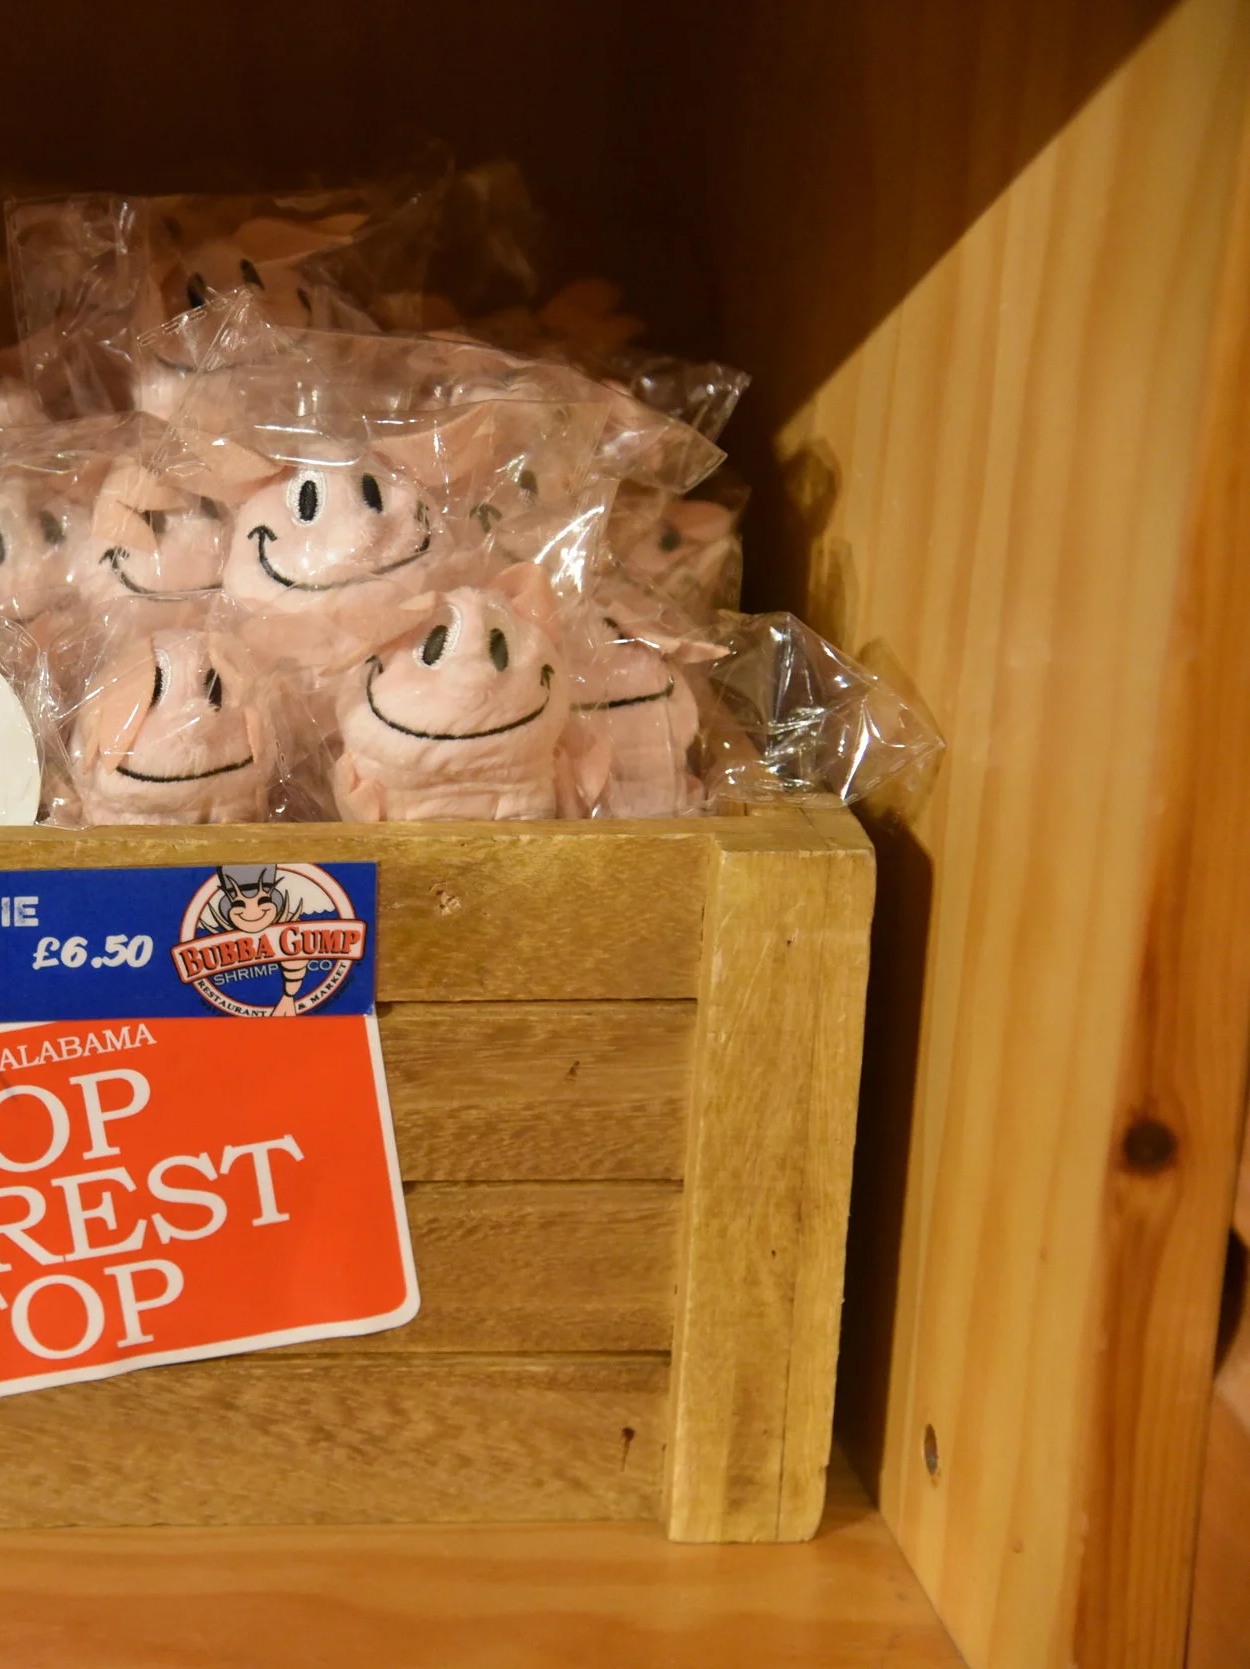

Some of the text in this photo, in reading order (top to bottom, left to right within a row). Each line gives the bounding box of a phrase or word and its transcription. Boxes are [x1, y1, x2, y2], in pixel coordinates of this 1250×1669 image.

[31, 934, 154, 971] £6.50
[179, 926, 362, 978] BUBBA GUMP
[213, 960, 333, 986] SHRIMP CO
[197, 980, 268, 1017] RESTAURANT
[310, 962, 347, 1003] MARKET
